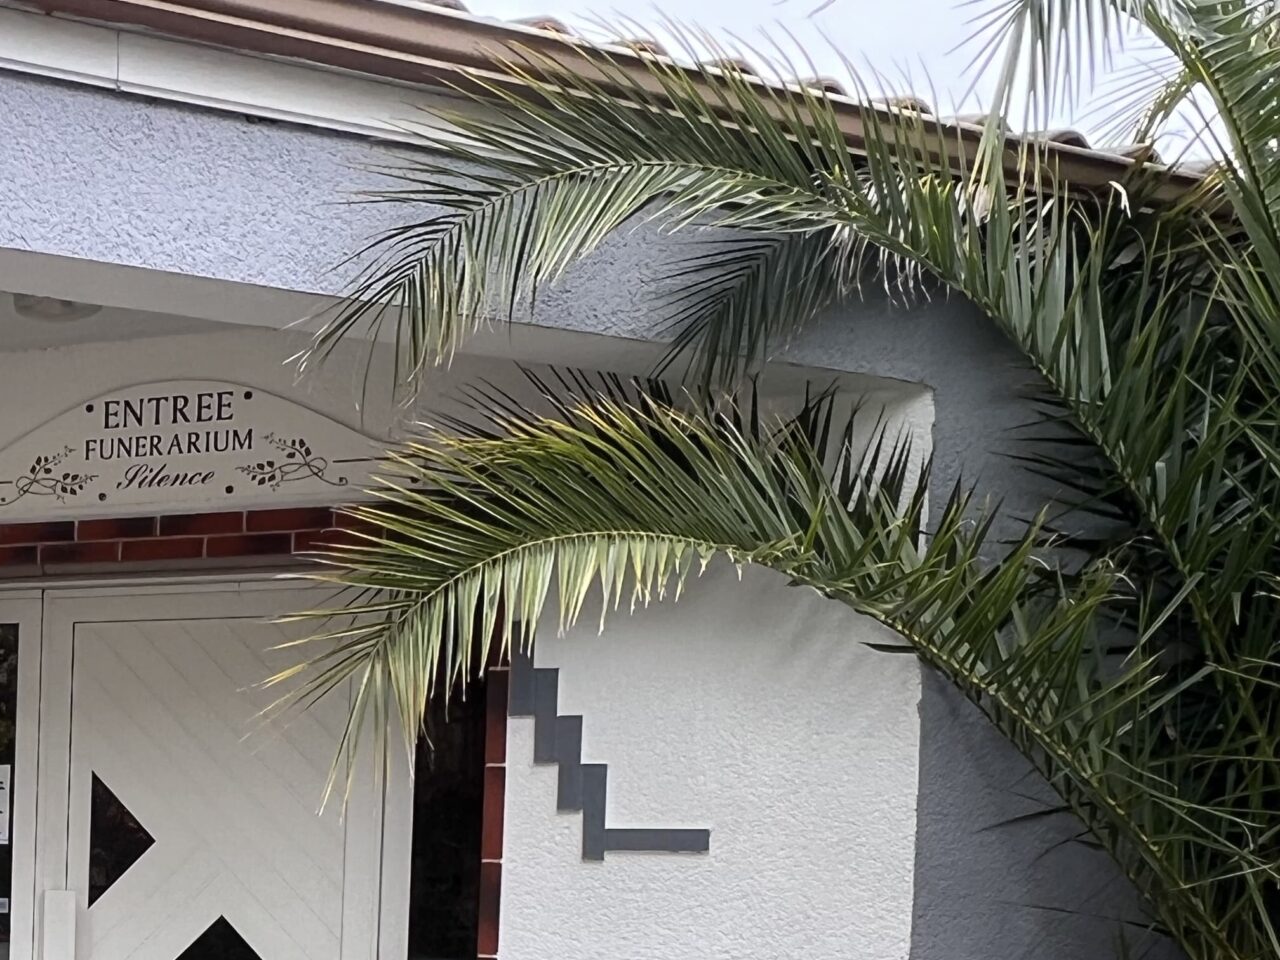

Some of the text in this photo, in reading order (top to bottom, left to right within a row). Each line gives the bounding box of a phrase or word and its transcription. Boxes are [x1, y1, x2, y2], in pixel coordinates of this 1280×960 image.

[104, 392, 234, 429] ENTREE
[85, 429, 253, 461] FUNERARIUM
[116, 463, 215, 490] Silence
